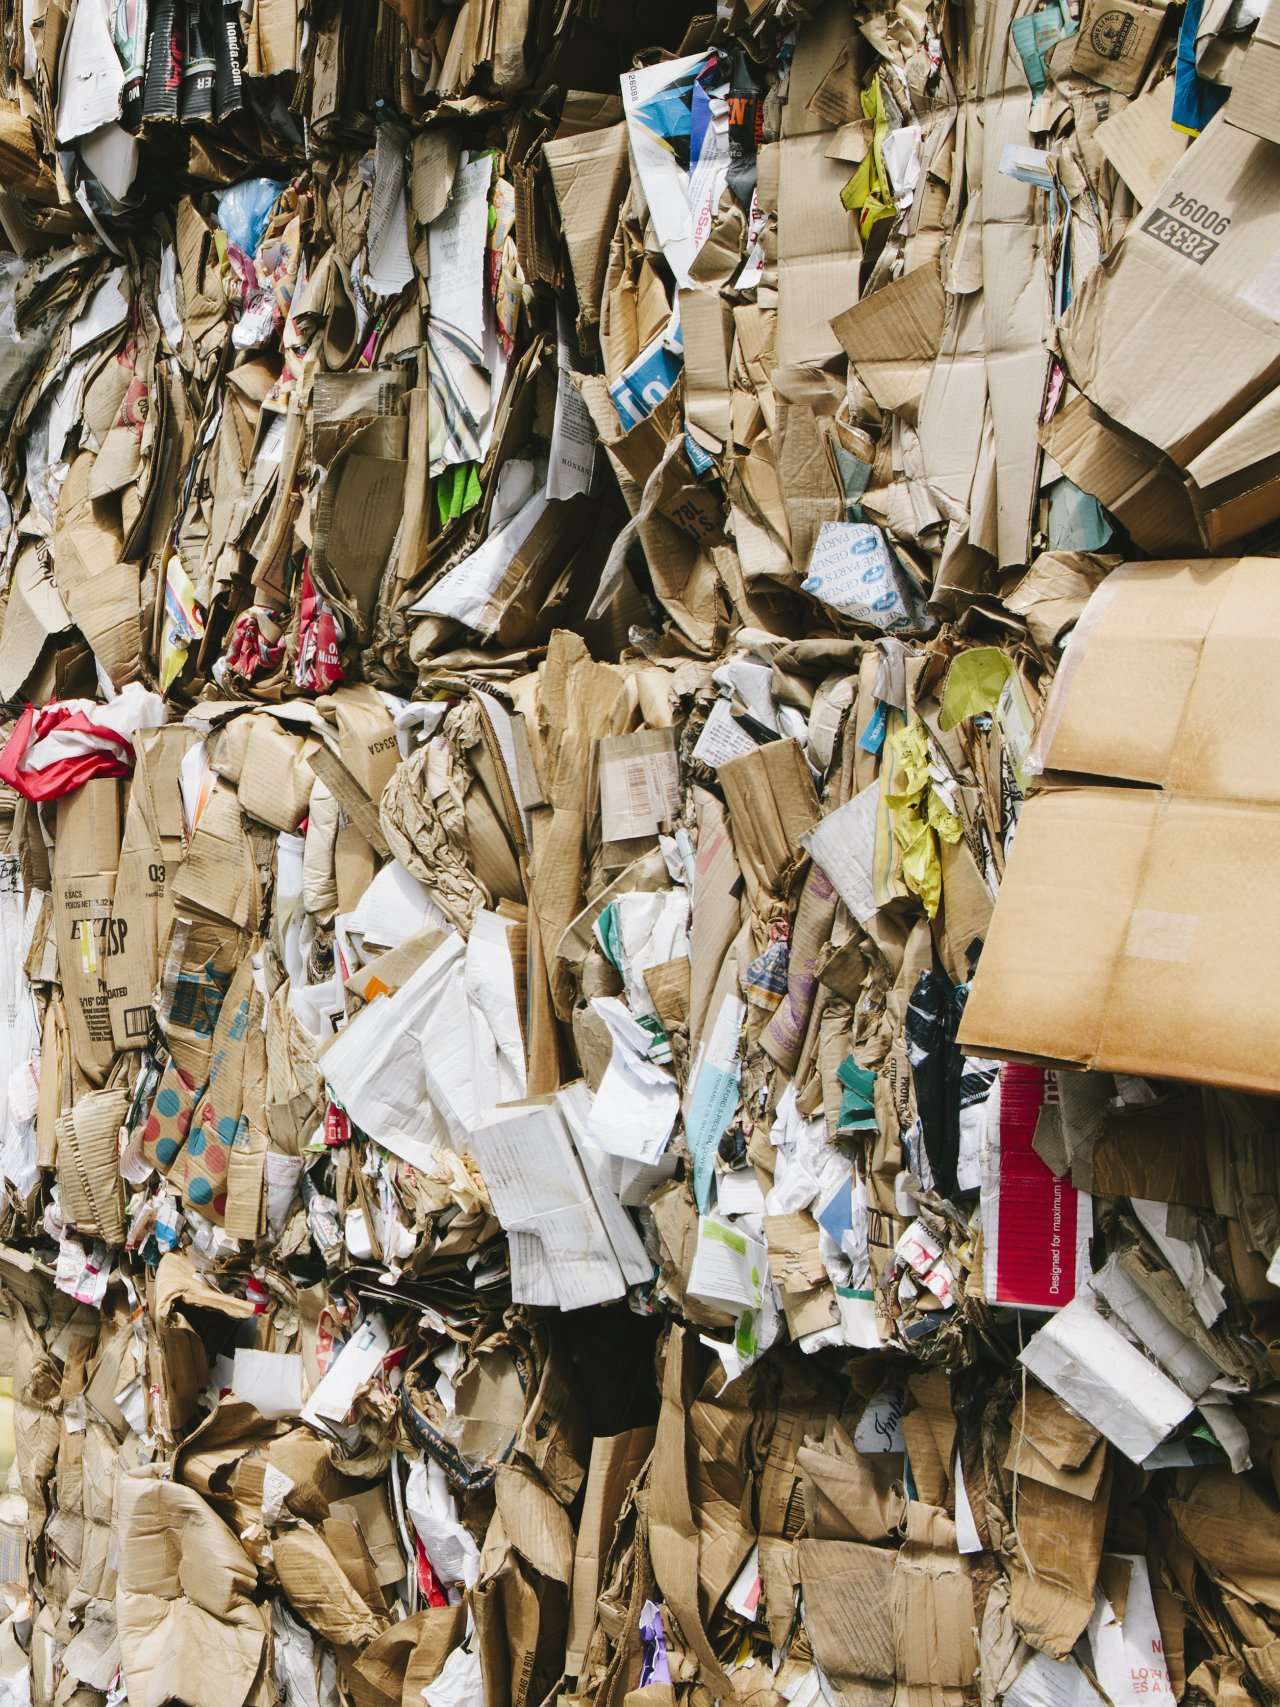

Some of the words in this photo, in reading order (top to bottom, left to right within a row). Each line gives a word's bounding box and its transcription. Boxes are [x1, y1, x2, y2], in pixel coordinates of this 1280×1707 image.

[225, 21, 242, 86] honda.com
[197, 77, 216, 90] ER
[1167, 190, 1233, 237] 90094
[1148, 214, 1215, 263] 28337
[148, 864, 166, 883] 03
[1052, 1185, 1062, 1232] maximum
[1052, 1233, 1062, 1248] for
[1049, 1249, 1062, 1294] Designed
[523, 1650, 537, 1669] BOX
[519, 1679, 531, 1694] BAG
